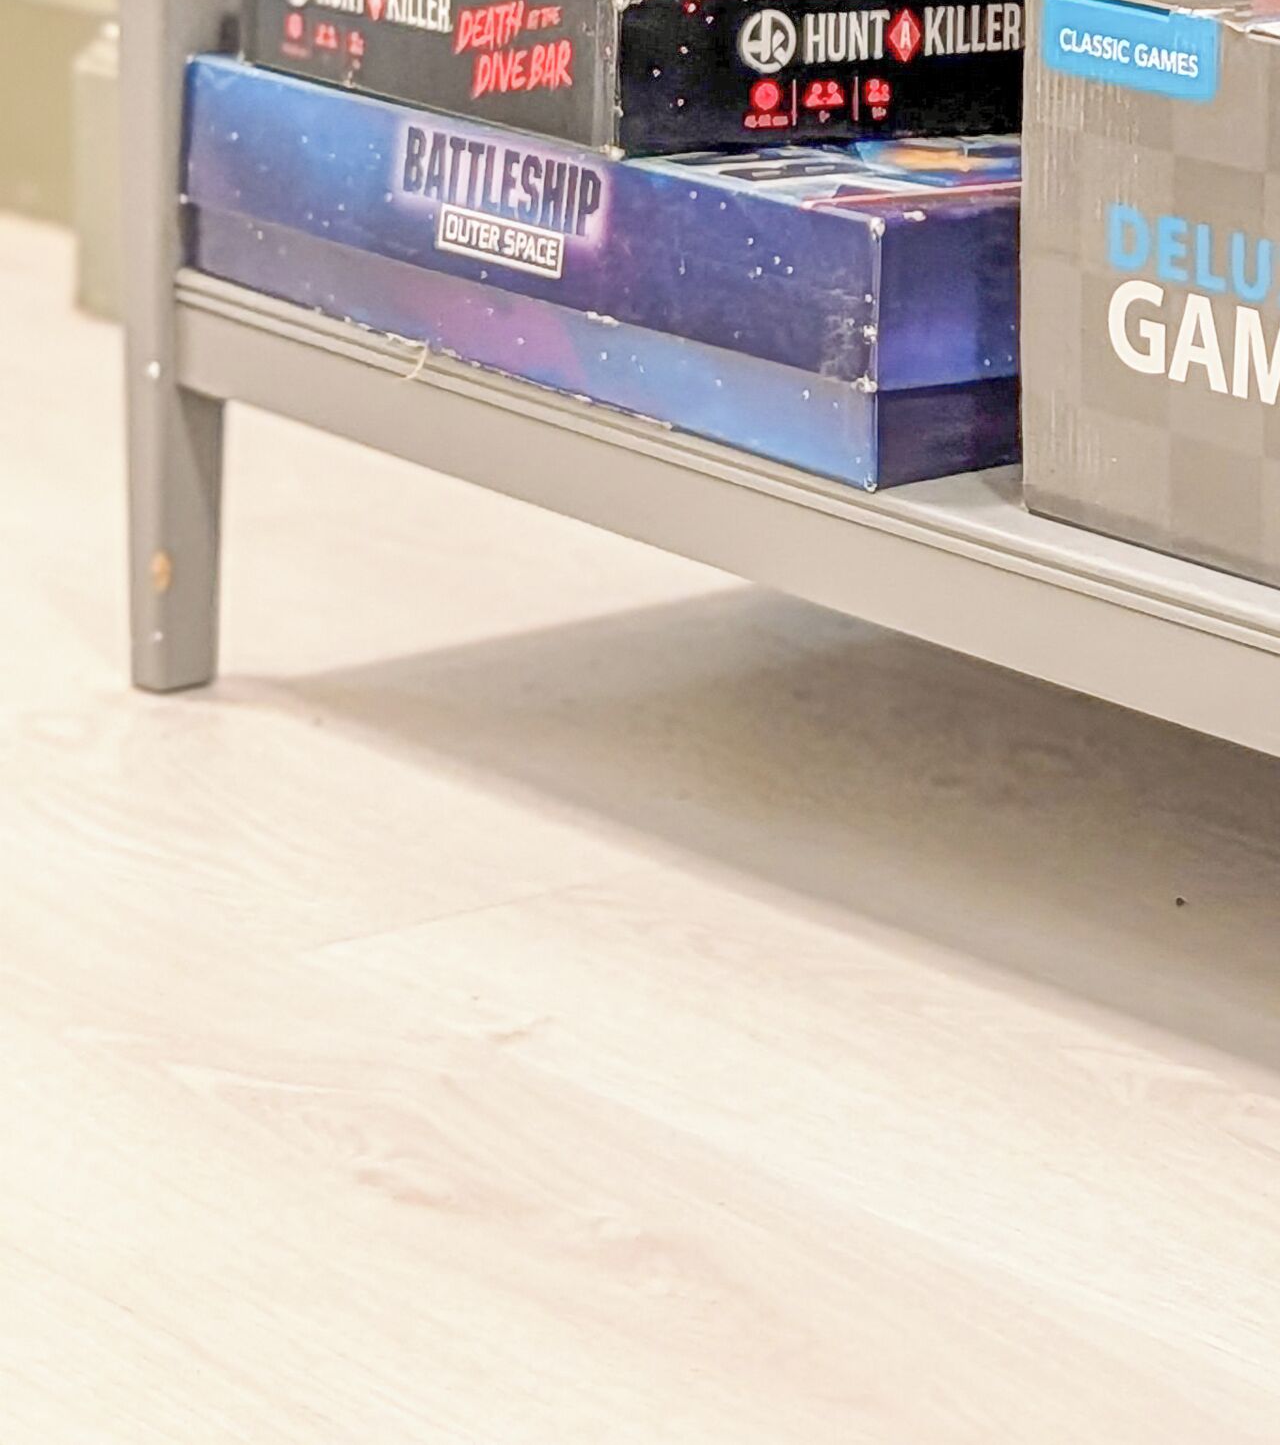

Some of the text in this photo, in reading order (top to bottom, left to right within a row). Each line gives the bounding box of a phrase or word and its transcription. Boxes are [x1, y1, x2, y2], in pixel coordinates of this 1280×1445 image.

[455, 0, 526, 55] DEATH
[803, 8, 891, 65] HUNT
[1058, 27, 1200, 80] CLASSIC GAMES
[470, 39, 574, 101] DIVE BAR
[402, 125, 603, 237] BATTLESHIP
[444, 214, 559, 267] OUTER SPACE
